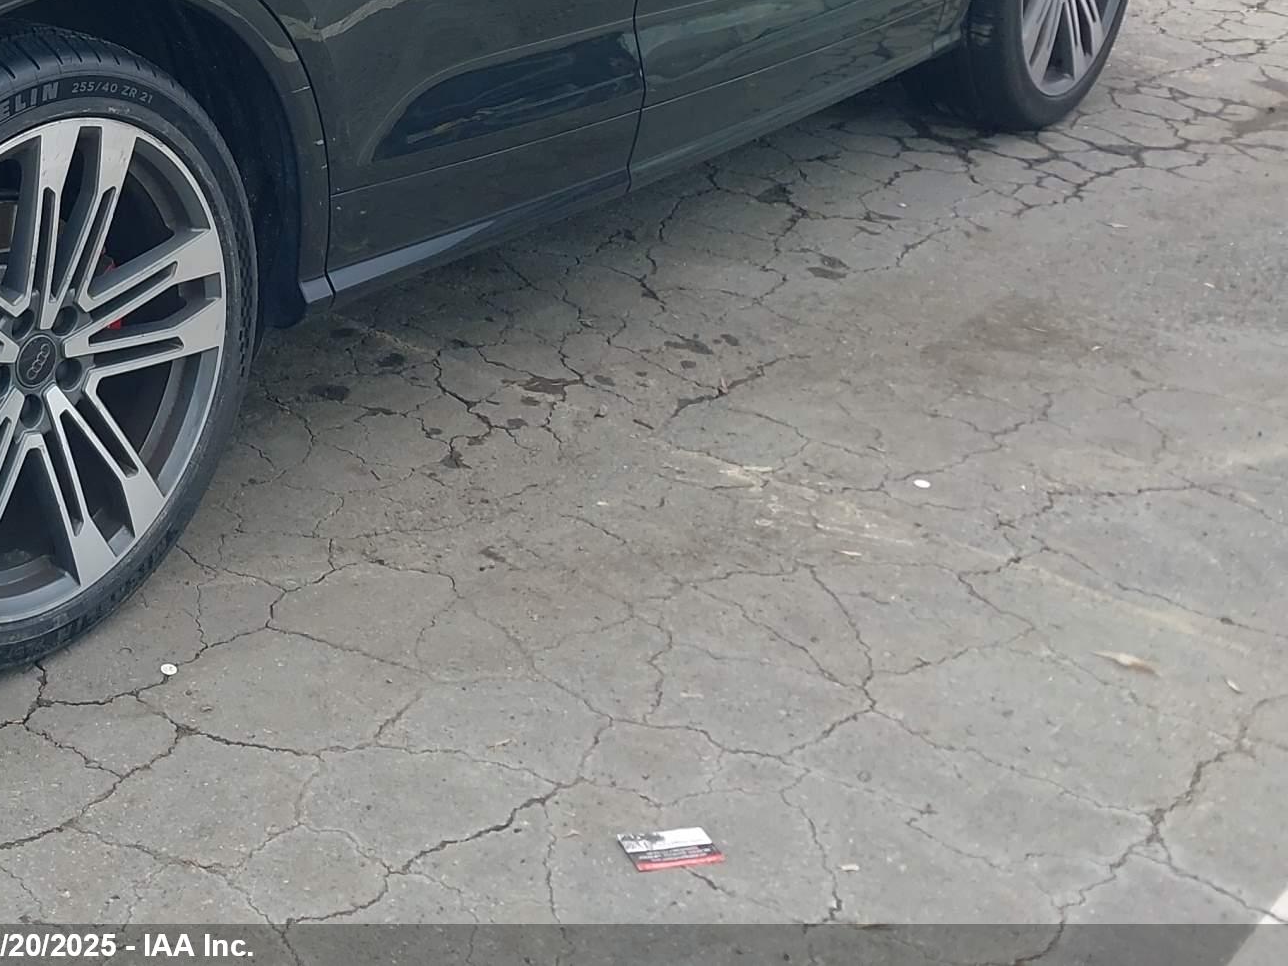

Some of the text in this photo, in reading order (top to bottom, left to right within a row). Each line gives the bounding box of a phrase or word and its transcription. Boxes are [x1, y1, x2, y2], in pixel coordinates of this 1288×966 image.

[72, 82, 118, 93] 255/40
[121, 85, 138, 98] ZR
[139, 92, 153, 104] 21
